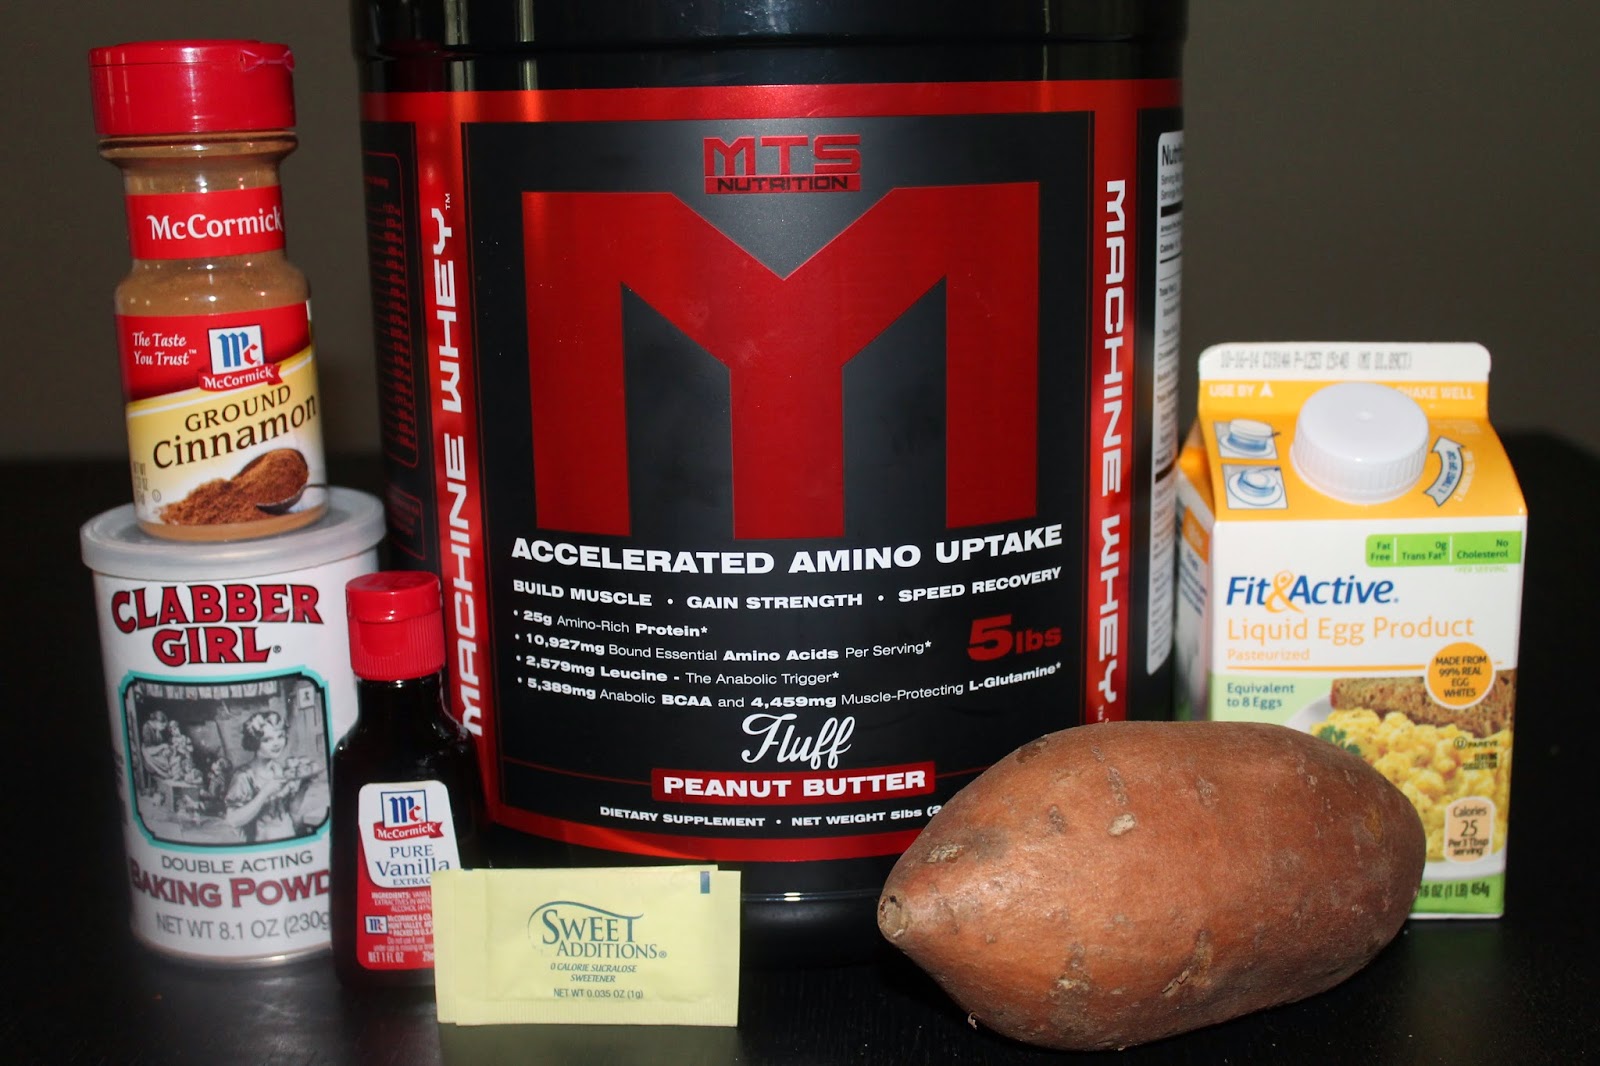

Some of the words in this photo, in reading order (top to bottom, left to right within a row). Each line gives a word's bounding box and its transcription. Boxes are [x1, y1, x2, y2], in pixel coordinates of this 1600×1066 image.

[703, 134, 862, 176] MTS
[717, 176, 849, 191] NUTRITION
[146, 205, 283, 240] McCormick
[132, 331, 150, 347] The
[152, 332, 187, 347] Taste
[1102, 179, 1126, 497] MACHINE
[134, 350, 153, 366] You
[202, 366, 274, 390] McCormick
[1209, 384, 1235, 398] USE
[1237, 384, 1256, 398] BY
[1441, 386, 1476, 400] WELL
[185, 385, 291, 432] GROUND
[153, 394, 316, 469] Cinnamon
[511, 537, 776, 574] ACCELERATED
[788, 544, 922, 573] AMINO
[935, 523, 1063, 564] UPTAKE
[1377, 542, 1391, 550] Fat
[1435, 541, 1447, 551] 0g
[1496, 539, 1509, 548] No
[1371, 552, 1391, 561] Free
[1402, 552, 1426, 561] Trans
[1457, 550, 1509, 560] Cholesterol
[443, 433, 483, 736] MACHINE
[513, 579, 564, 599] BUILD
[570, 587, 653, 607] MUSCLE
[686, 595, 739, 610] GAIN
[745, 593, 863, 610] STRENGTH
[898, 583, 966, 603] SPEED
[971, 566, 1063, 595] RECOVERY
[111, 583, 325, 634] CLABBER
[523, 609, 552, 626] 25g
[556, 615, 630, 634] Amino-Rich
[967, 613, 1063, 662] 5lbs
[1227, 618, 1309, 646] Liquid
[1317, 618, 1365, 647] Egg
[1374, 615, 1475, 639] Product
[526, 632, 605, 655] 10,927mg
[609, 643, 651, 659] Bound
[656, 647, 718, 661] Essential
[722, 649, 781, 662] Amino
[786, 648, 840, 662] Acids
[845, 646, 868, 659] Per
[1227, 648, 1311, 661] Pasteurized
[1436, 655, 1460, 666] MADE
[1462, 655, 1487, 665] FROM
[525, 654, 596, 677] 2,579mg
[600, 665, 668, 682] Leucine
[685, 671, 713, 685] The
[715, 672, 778, 685] Anabolic
[1462, 667, 1483, 676] REAL
[1227, 682, 1295, 697] Equivalent
[1451, 677, 1469, 687] EGG
[527, 676, 597, 700] 5,389mg
[600, 688, 656, 705] Anabolic
[661, 693, 713, 708] BCAA
[718, 696, 746, 709] and
[750, 695, 837, 709] 4,459mg
[841, 682, 964, 707] Muscle-Protecting
[1444, 688, 1476, 698] WHITES
[1227, 697, 1241, 708] to
[1242, 697, 1250, 708] 8
[1252, 697, 1283, 710] Eggs
[740, 713, 856, 770] Fluff
[663, 775, 792, 798] PEANUT
[802, 769, 926, 797] BUTTER
[599, 805, 658, 822] DIETARY
[662, 812, 766, 827] SUPPLEMENT
[790, 815, 821, 827] NET
[822, 810, 887, 825] WEIGHT
[890, 806, 923, 820] 5lbs
[1453, 805, 1488, 818] Calories
[376, 823, 436, 840] McCormick
[1460, 819, 1478, 837] 25
[390, 844, 434, 858] PURE
[1448, 838, 1461, 848] Per
[1453, 848, 1484, 857] serving
[161, 854, 235, 874] DOUBLE
[240, 850, 314, 873] ACTING
[375, 857, 450, 877] Vanilla
[128, 857, 222, 908] BAKING
[229, 868, 330, 909] POWD
[393, 877, 431, 887] EXTRAC
[1431, 883, 1444, 898] OZ
[156, 911, 183, 935] NET
[187, 920, 214, 939] WT
[219, 922, 244, 941] 8.1
[251, 918, 280, 939] OZ
[284, 910, 330, 938] (230g
[541, 904, 643, 945] SWEET
[550, 962, 556, 971] 0
[557, 962, 589, 972] CALORIE
[590, 963, 637, 973] SUCRALOSE
[570, 973, 616, 983] SWEETENER
[553, 988, 568, 998] NET
[571, 988, 584, 998] WT
[586, 989, 611, 999] 0.035
[613, 989, 624, 999] OZ
[627, 989, 643, 1000] (1g)
